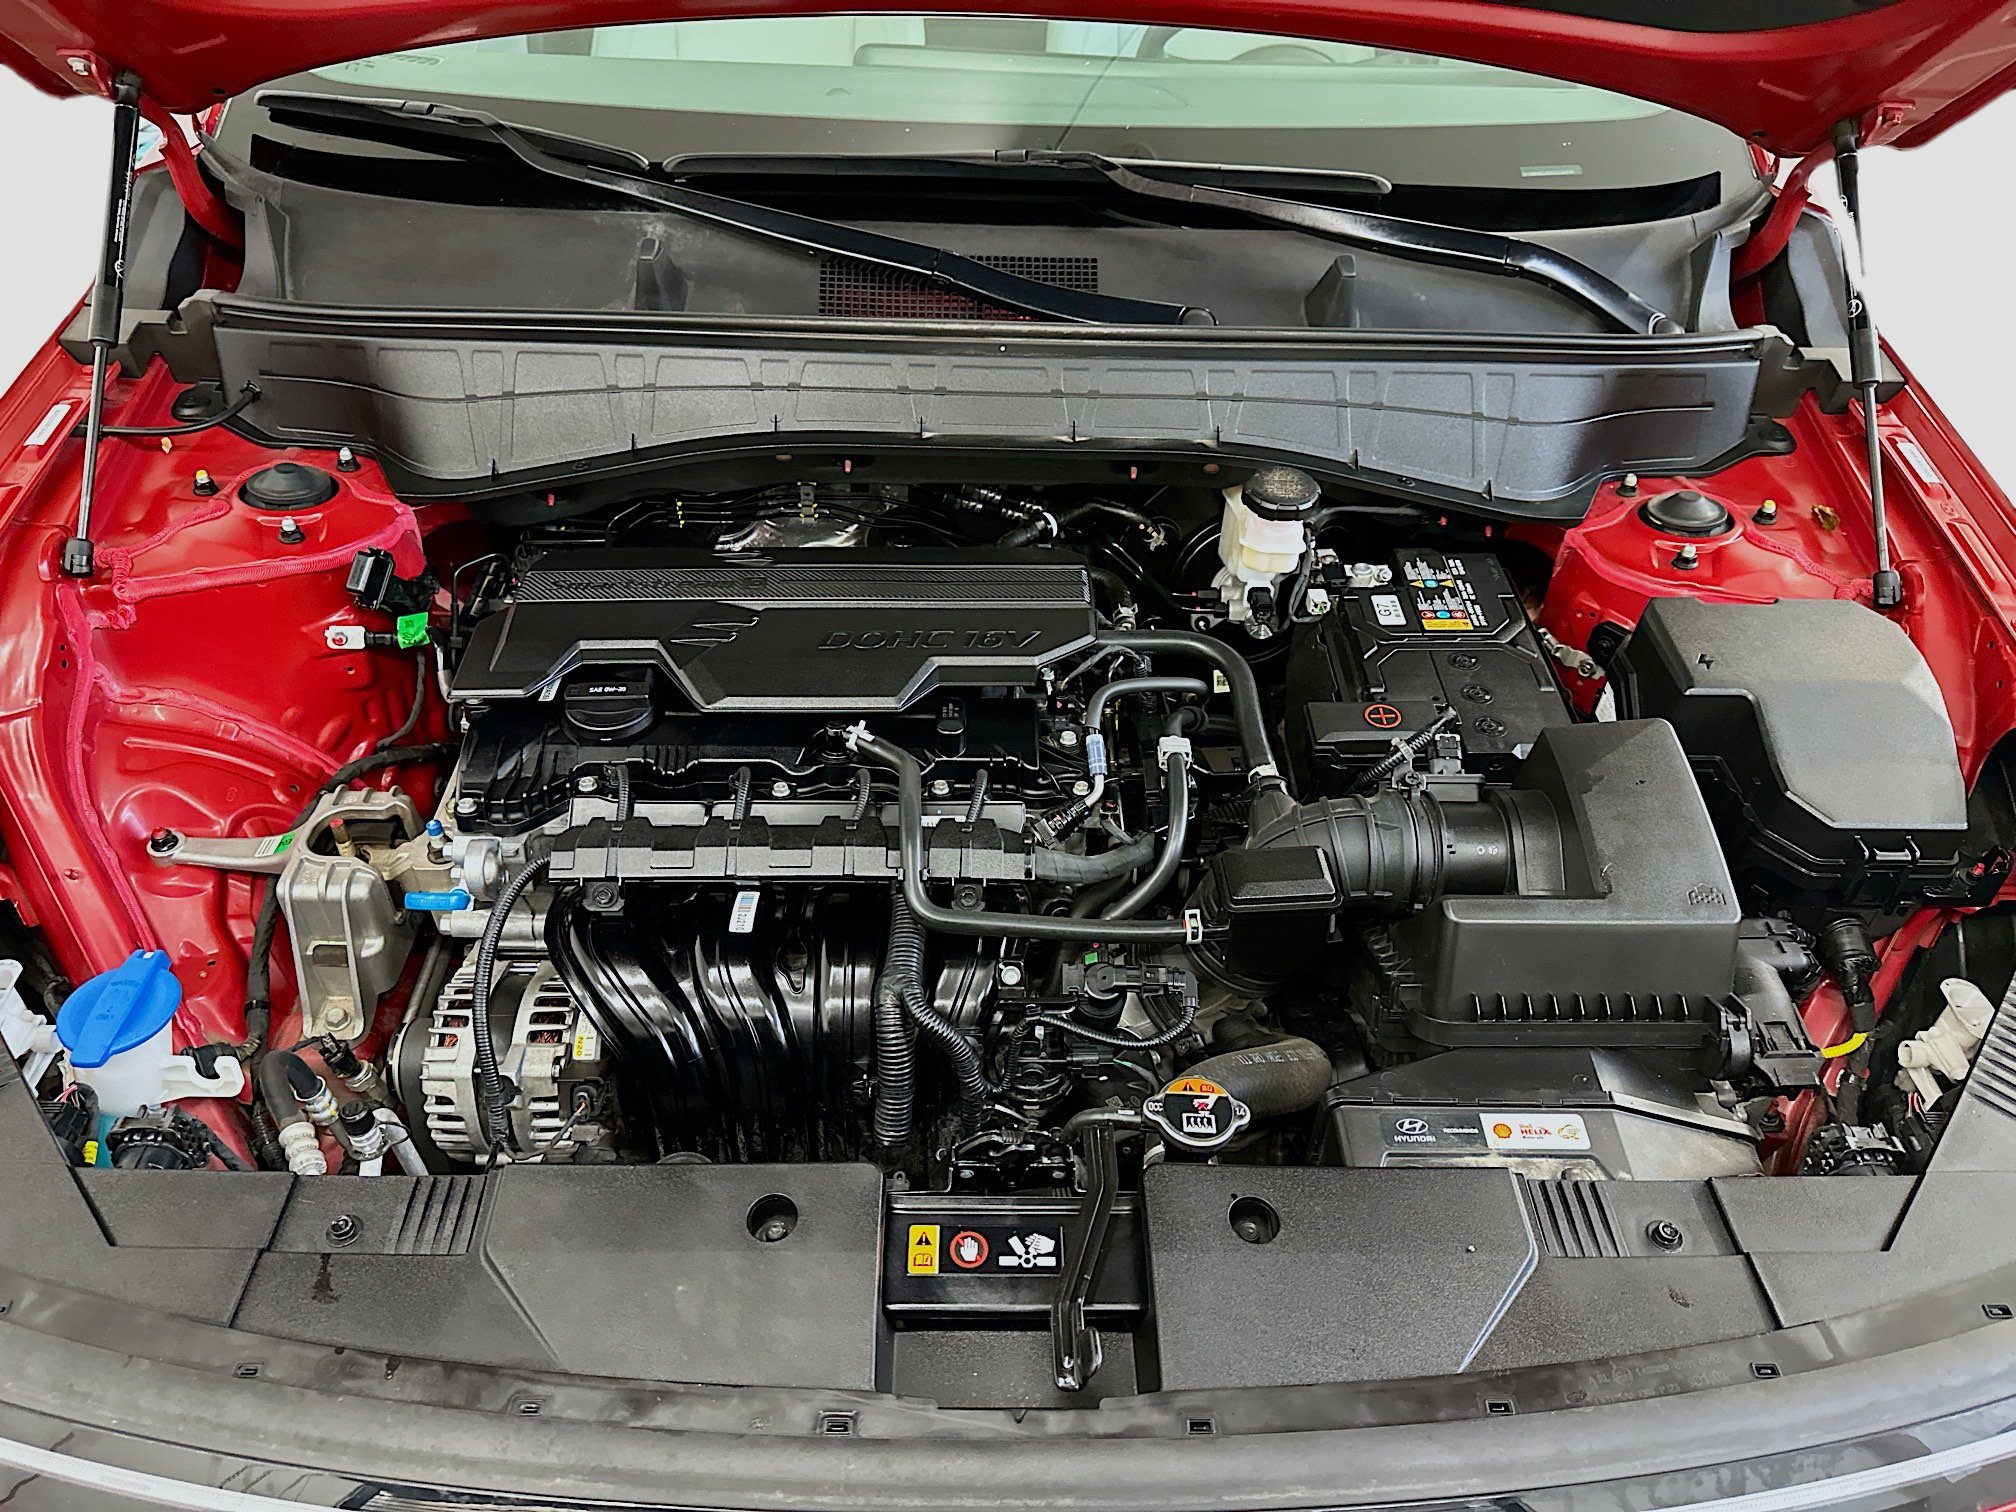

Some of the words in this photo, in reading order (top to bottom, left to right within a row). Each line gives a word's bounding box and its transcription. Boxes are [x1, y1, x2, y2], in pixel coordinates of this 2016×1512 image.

[818, 630, 954, 649] DOHC
[963, 630, 1042, 649] 16V
[1394, 1135, 1436, 1143] HYUNDAI
